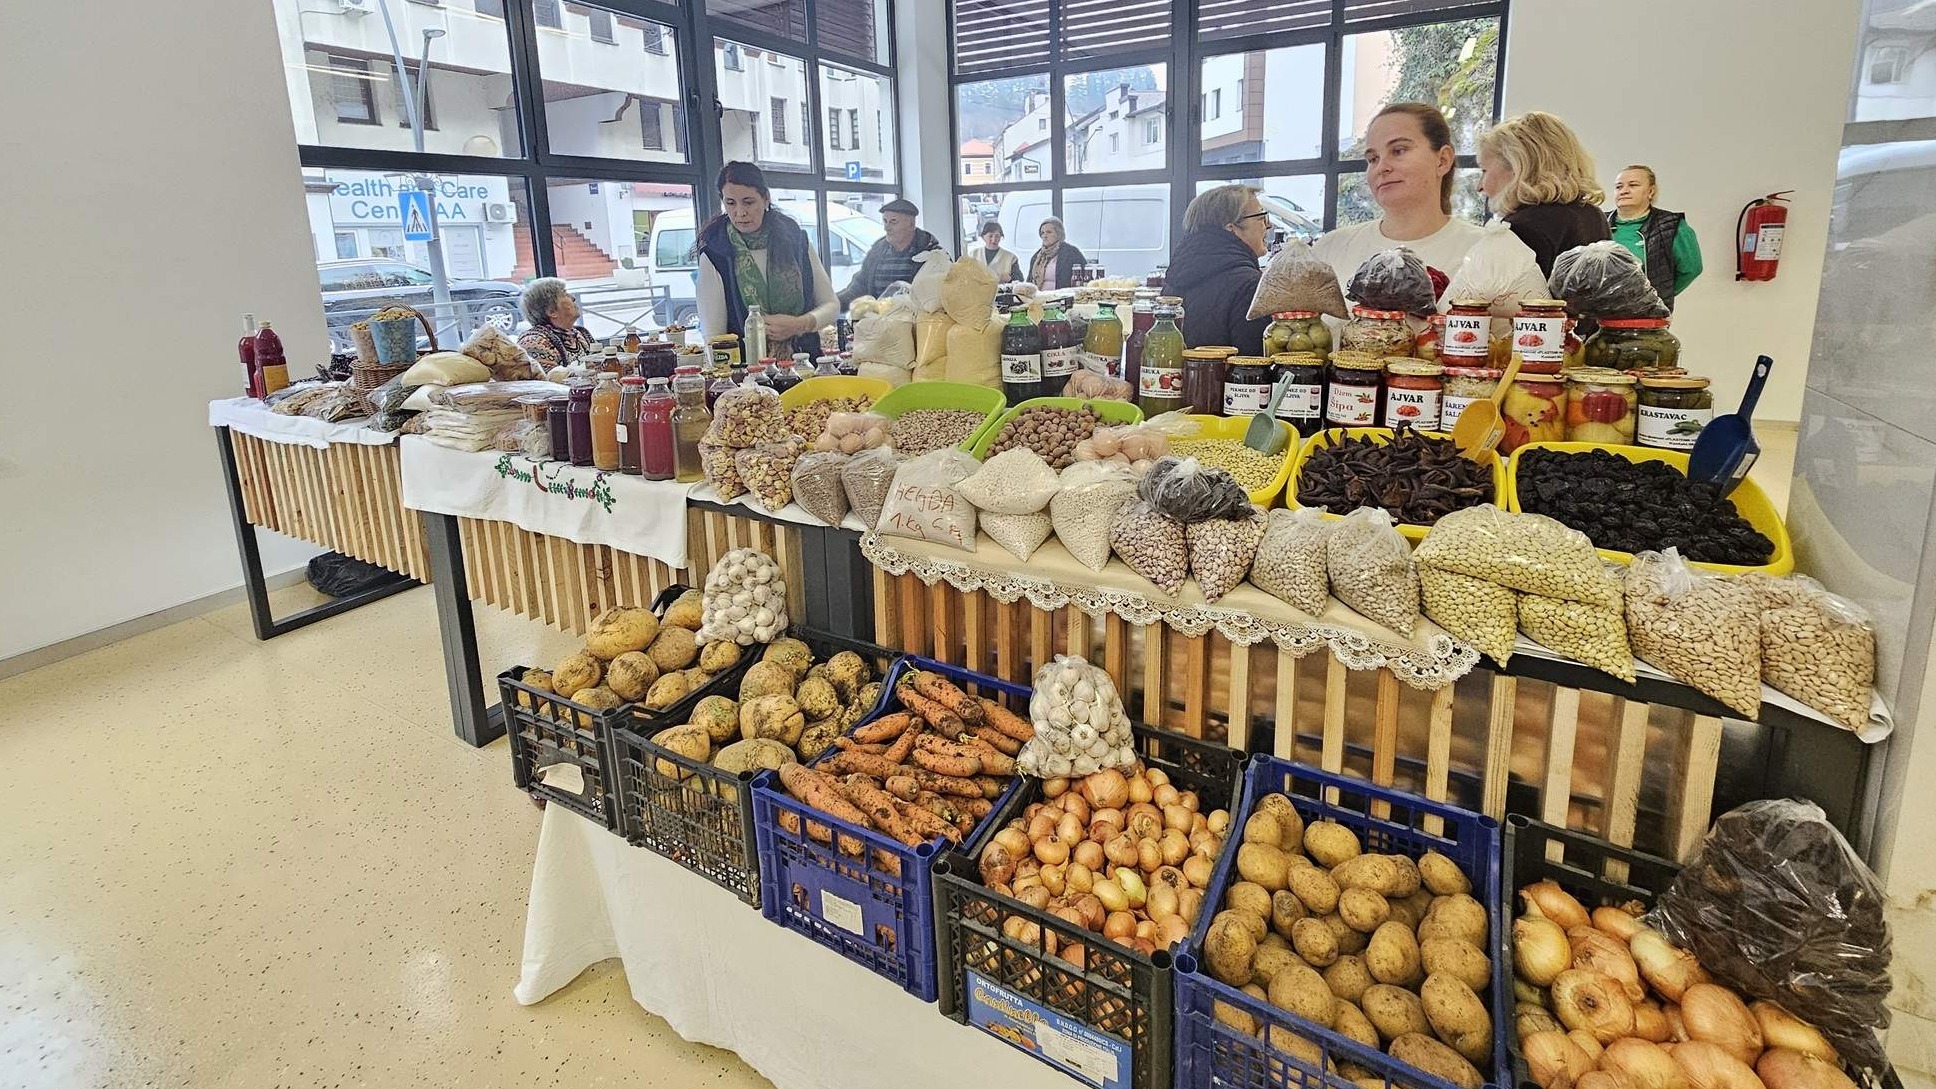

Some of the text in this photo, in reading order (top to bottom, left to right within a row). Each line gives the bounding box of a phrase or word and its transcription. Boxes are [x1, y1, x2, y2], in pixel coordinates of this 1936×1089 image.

[849, 163, 858, 178] P
[441, 181, 489, 199] Care
[1448, 320, 1480, 329] AJVAR
[1515, 322, 1547, 332] AJVAR
[1390, 392, 1424, 403] AJVAR
[1640, 409, 1688, 421] KRASTAVAC
[976, 976, 1024, 1008] ORTOFRUTTA
